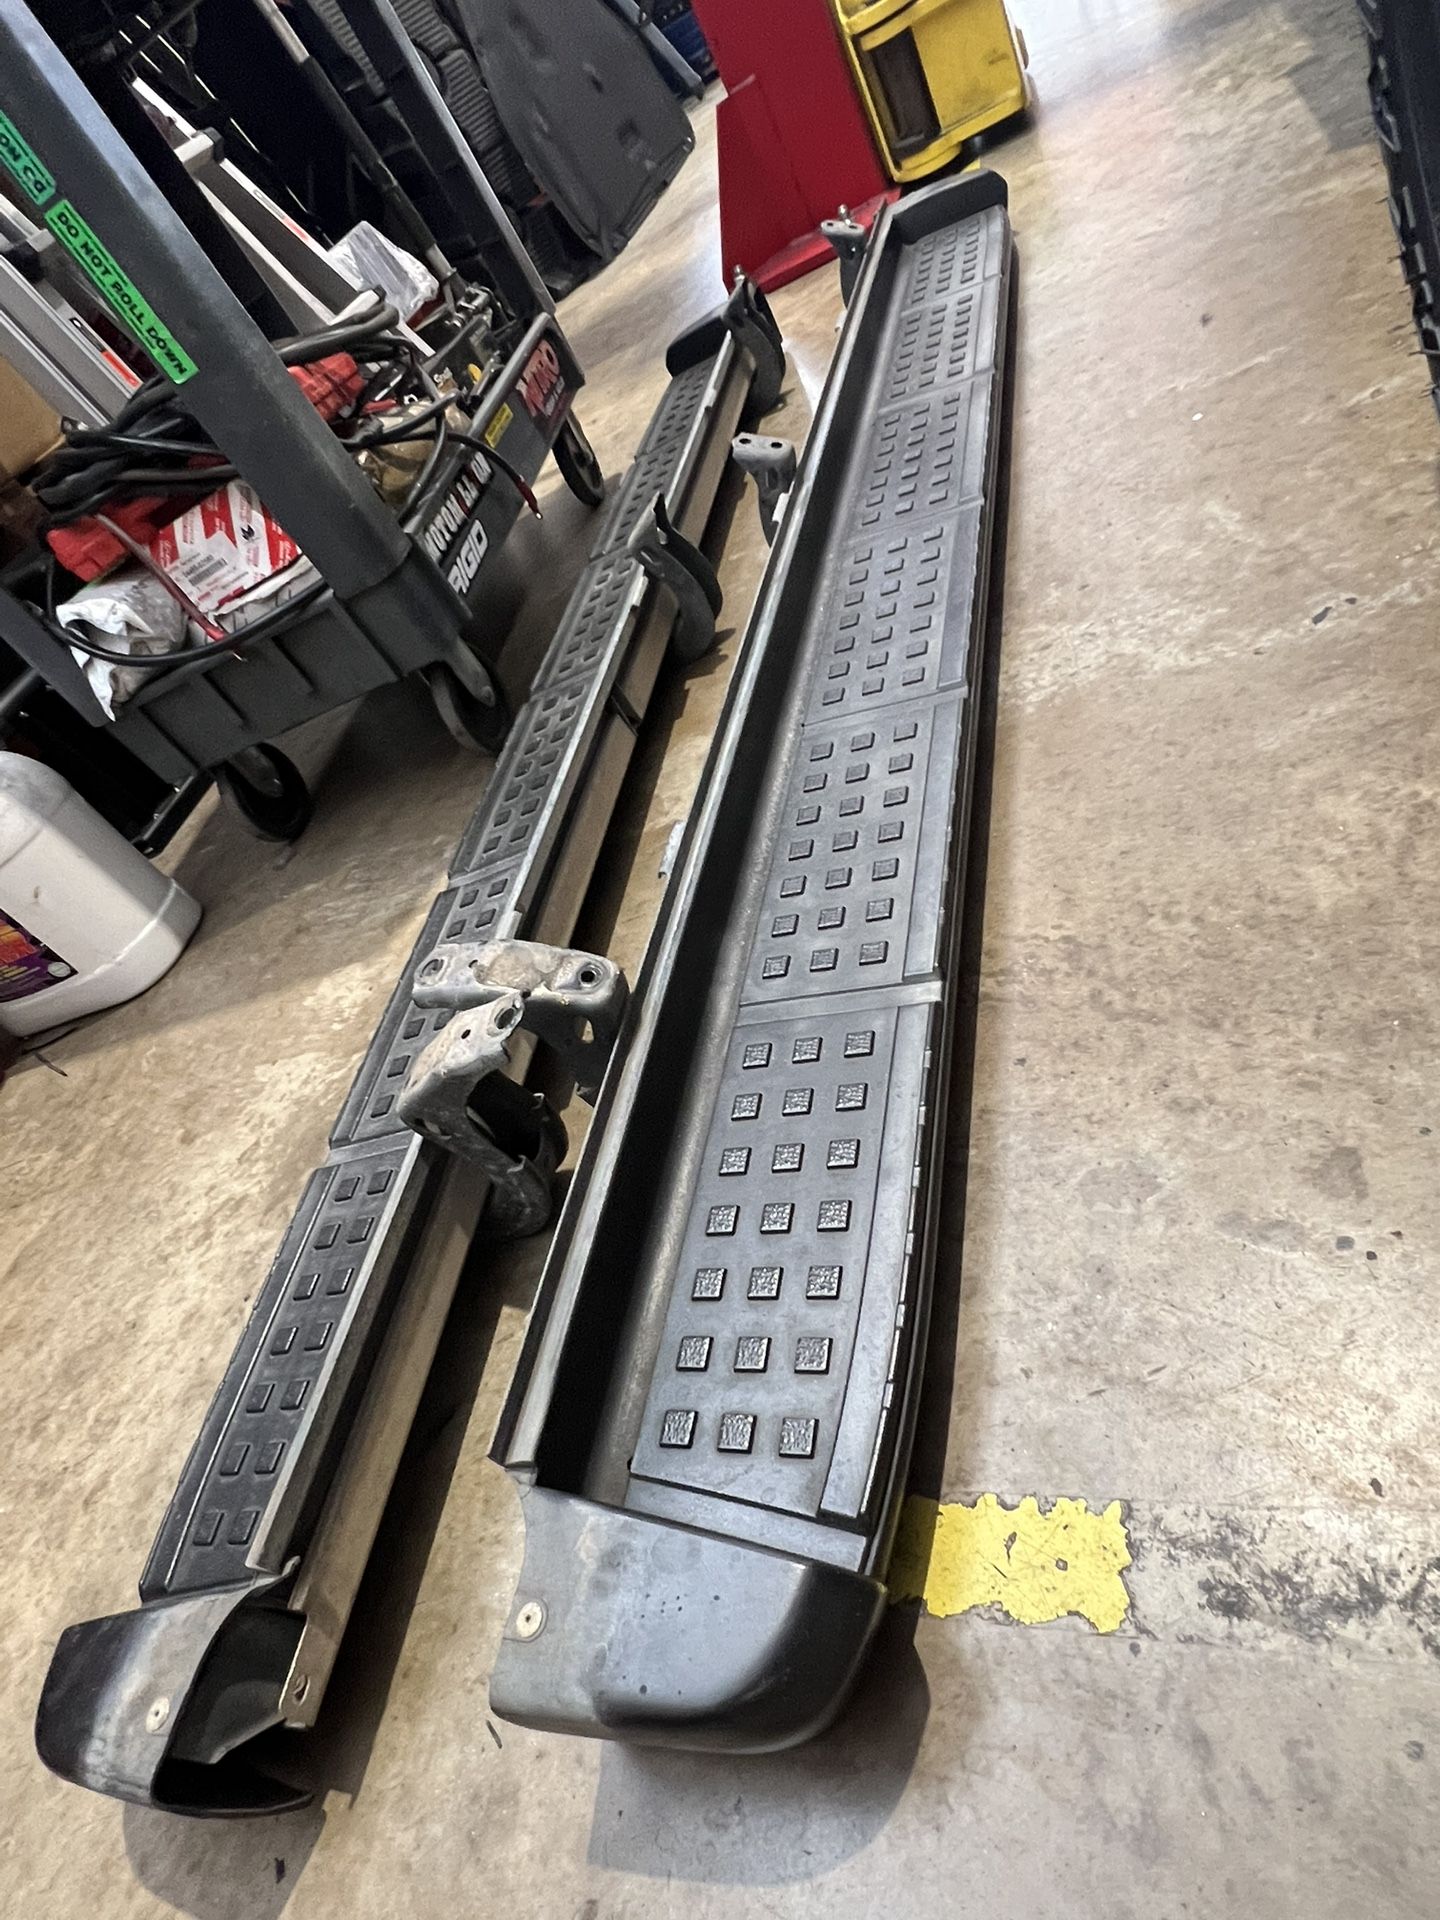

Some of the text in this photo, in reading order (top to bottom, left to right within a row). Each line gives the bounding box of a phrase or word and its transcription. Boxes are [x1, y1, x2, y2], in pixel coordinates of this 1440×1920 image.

[57, 212, 79, 239] DO
[80, 241, 112, 277] NOT
[110, 281, 145, 326] ROLL
[146, 326, 188, 375] DOWN
[447, 519, 488, 594] RIGID
